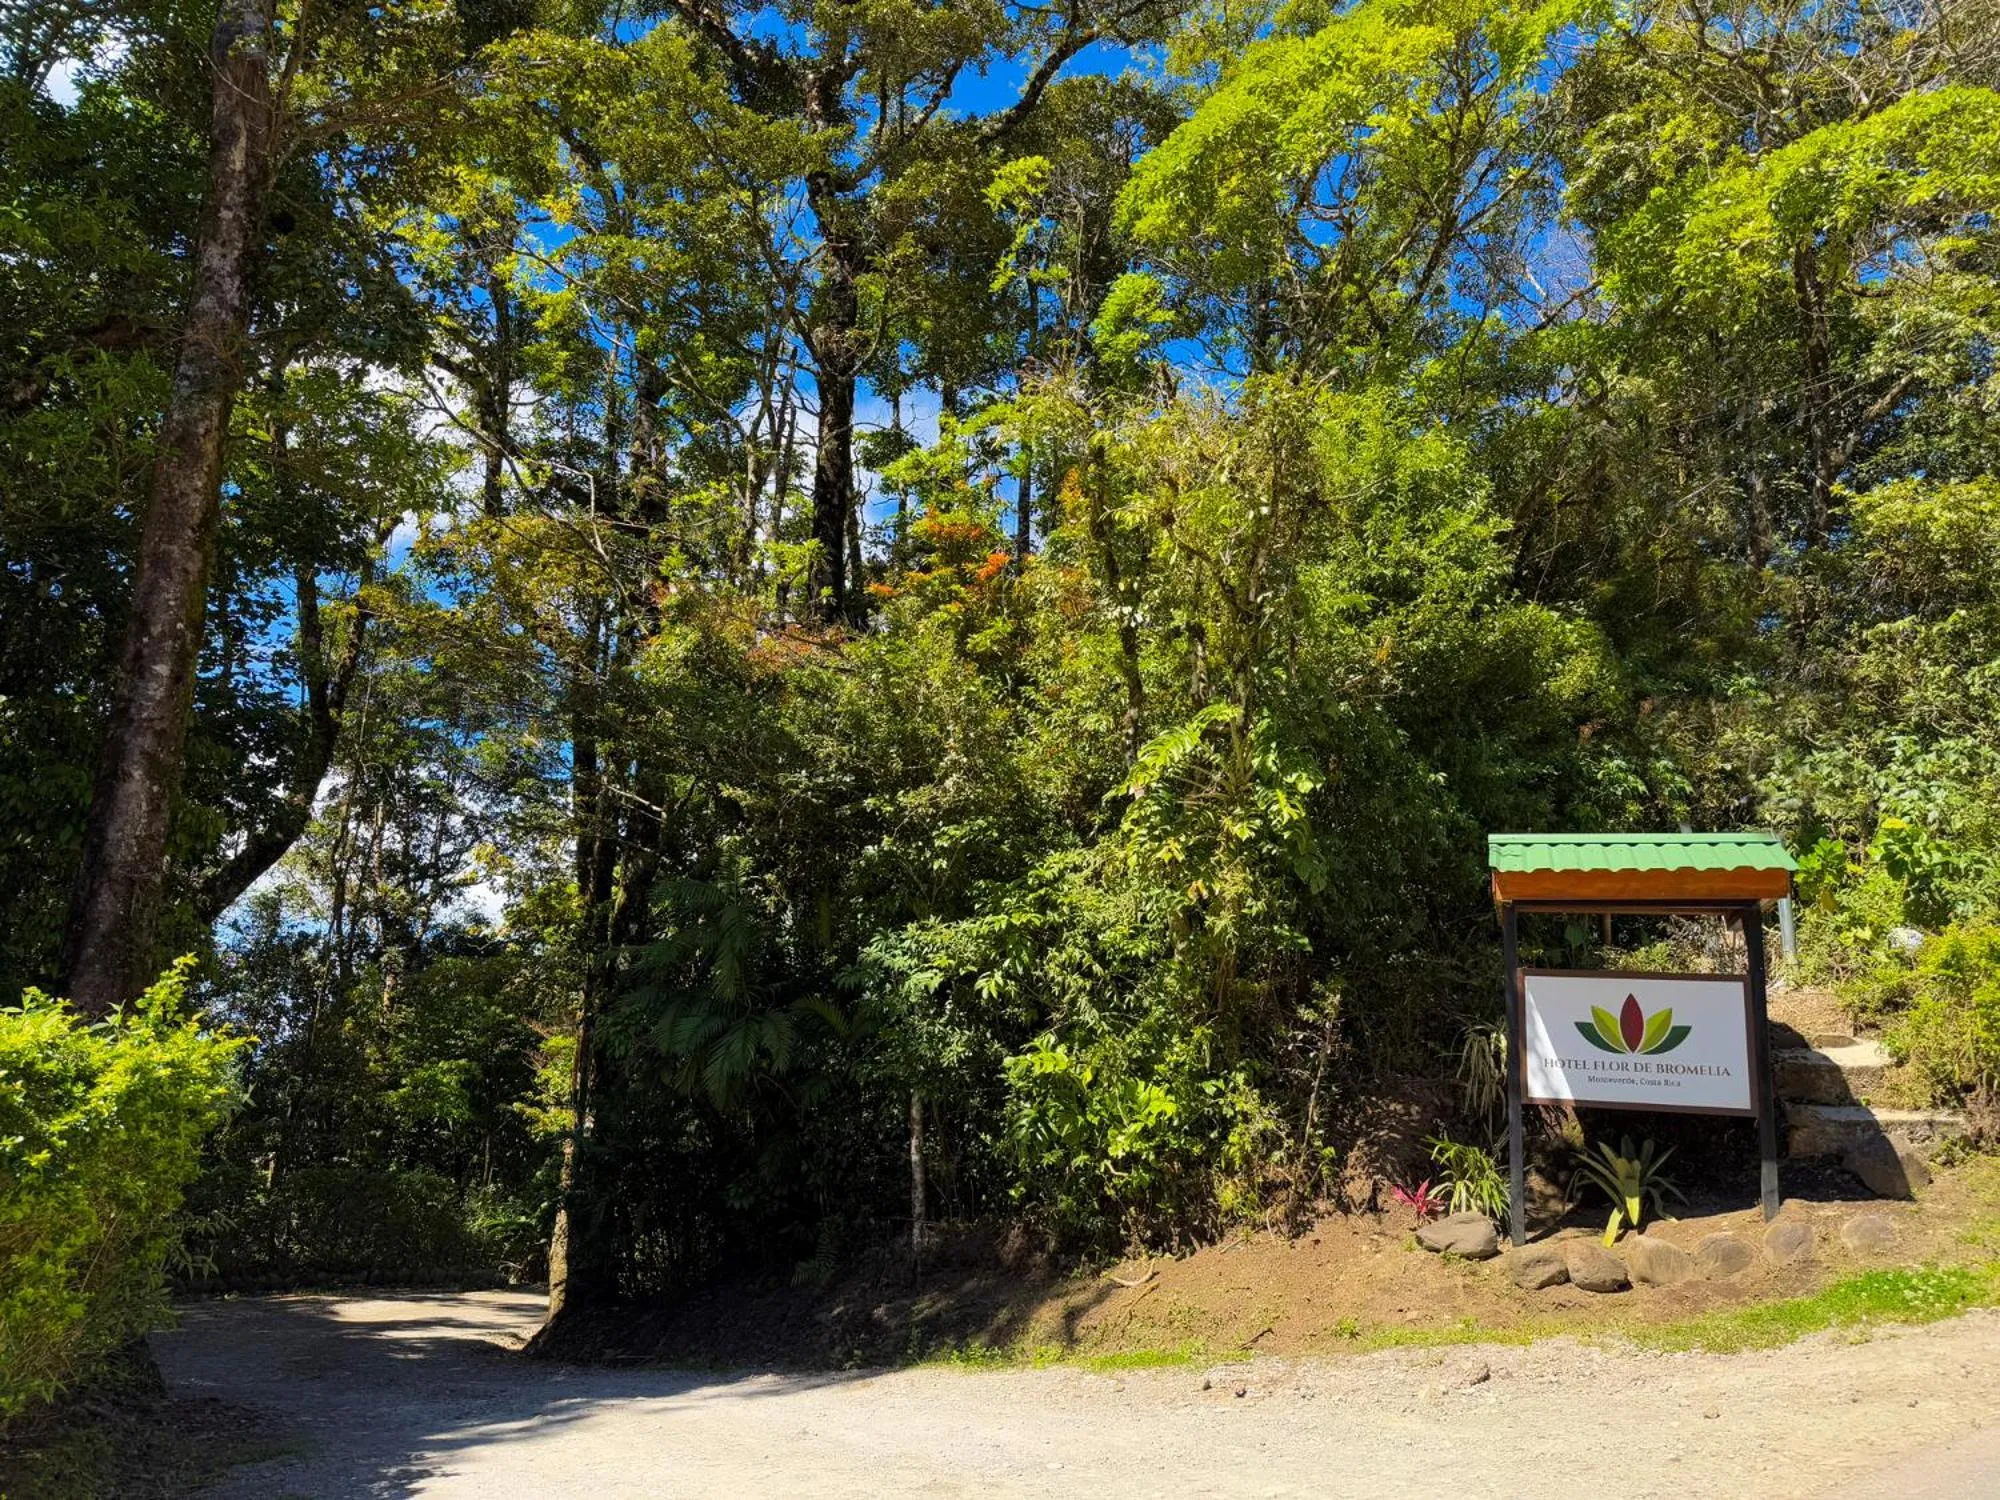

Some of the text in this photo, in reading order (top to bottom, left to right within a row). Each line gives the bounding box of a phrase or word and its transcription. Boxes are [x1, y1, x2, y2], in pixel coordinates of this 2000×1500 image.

[1544, 1058, 1731, 1077] HOTEL FLOR DE BROMELIA
